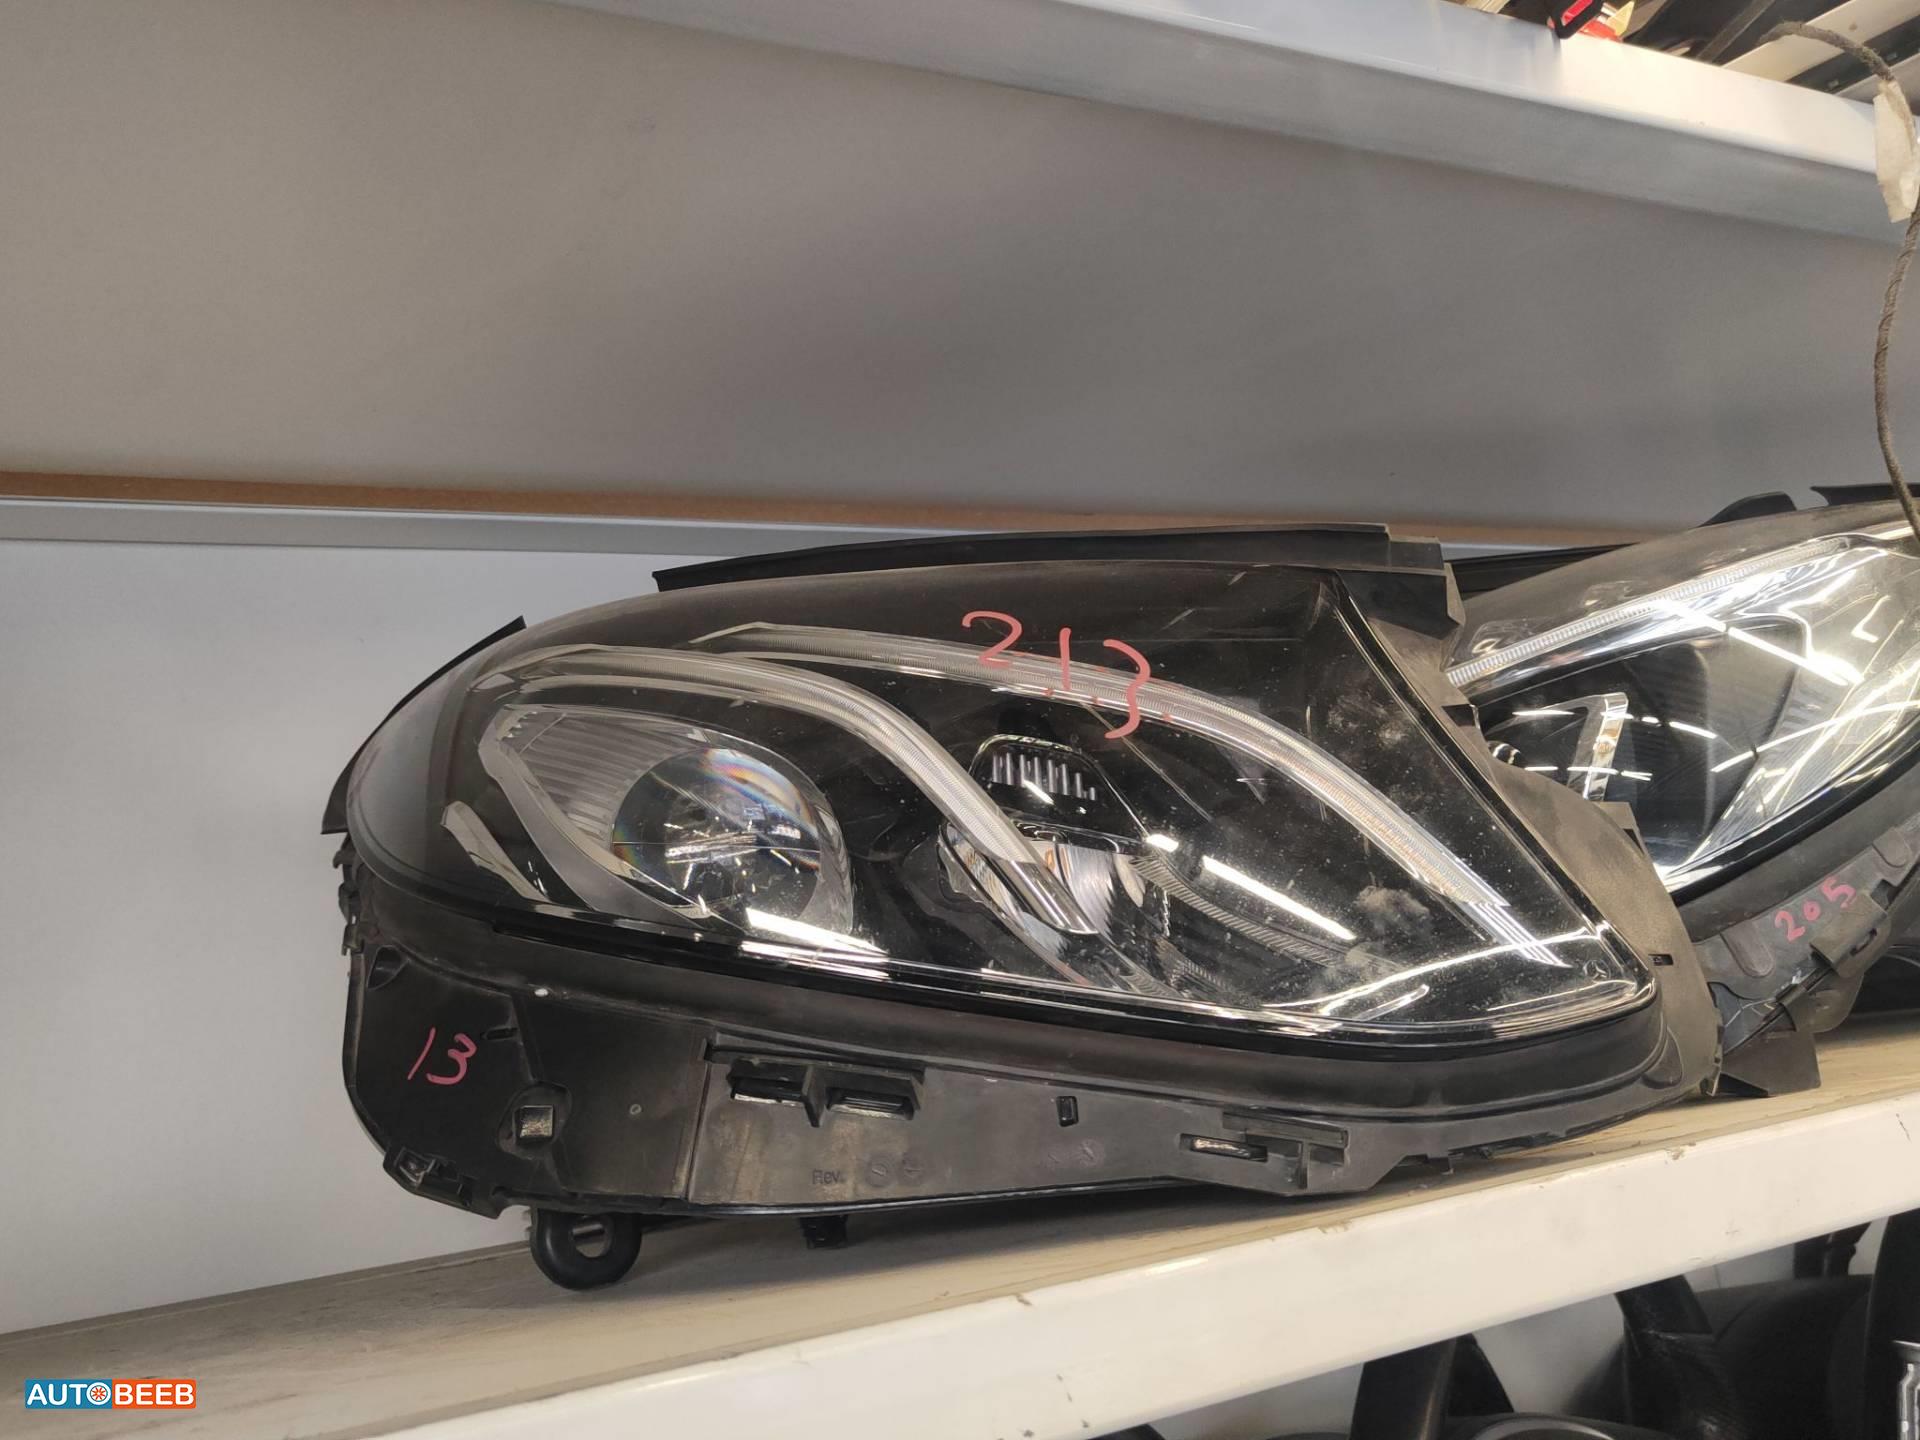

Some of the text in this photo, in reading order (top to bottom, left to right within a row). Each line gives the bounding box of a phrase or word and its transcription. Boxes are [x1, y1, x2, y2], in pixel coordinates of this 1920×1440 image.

[962, 610, 1151, 739] 213
[1774, 875, 1856, 943] 205
[407, 1027, 477, 1085] 13
